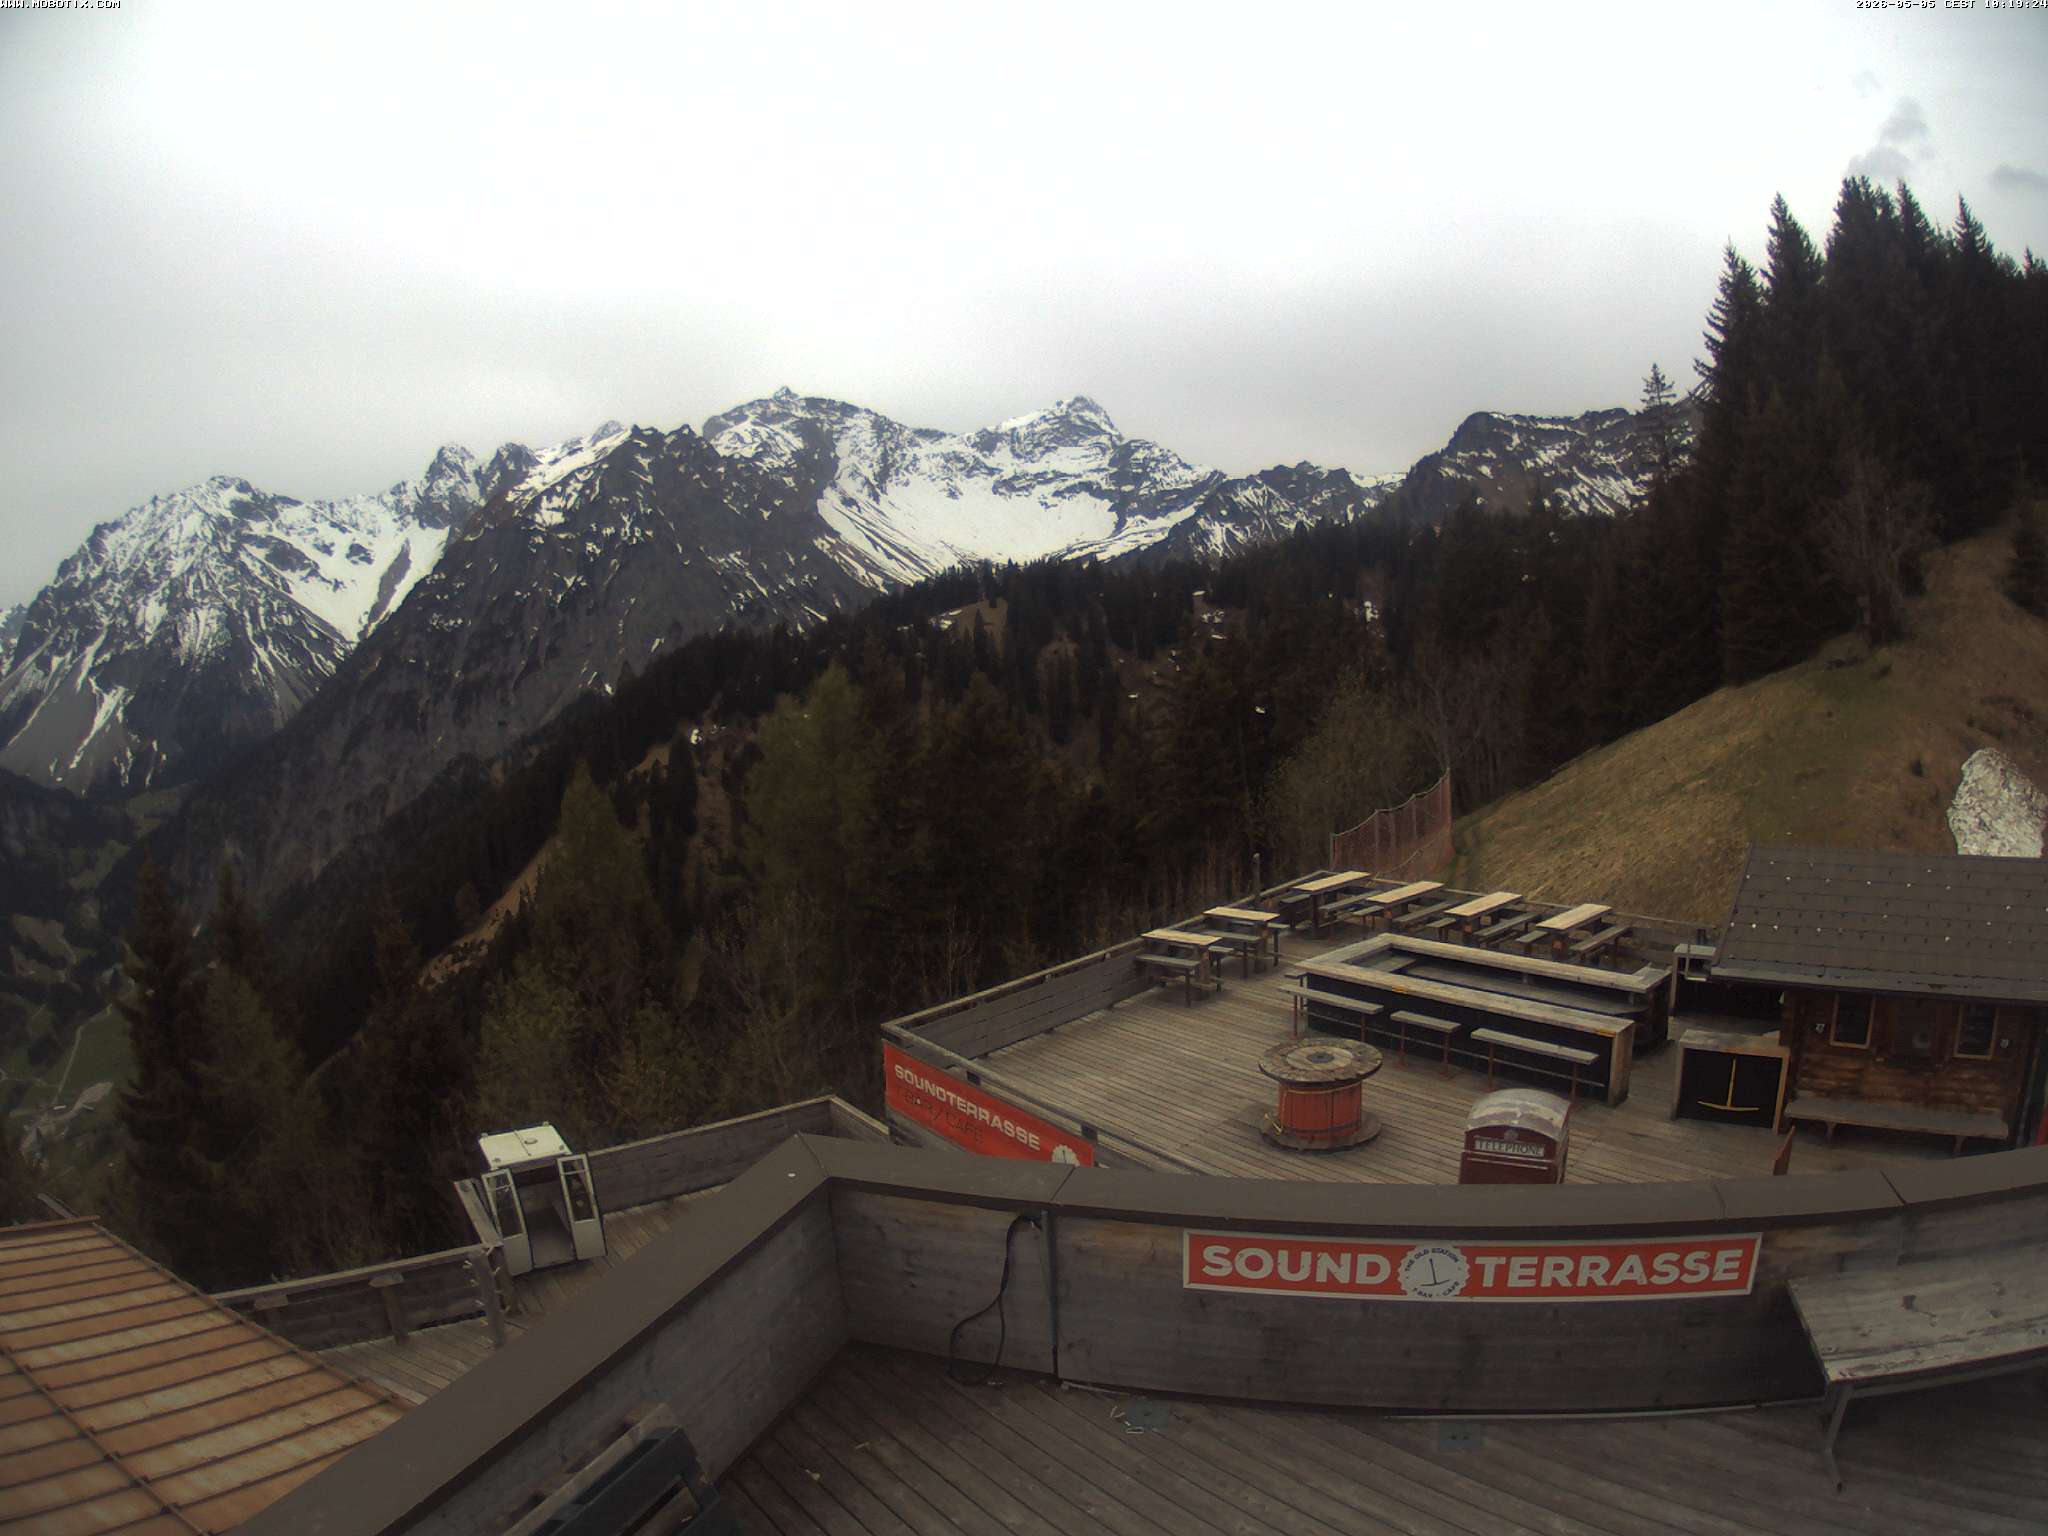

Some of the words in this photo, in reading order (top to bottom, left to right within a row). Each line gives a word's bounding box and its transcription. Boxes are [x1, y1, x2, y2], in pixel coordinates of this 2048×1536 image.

[894, 1064, 1041, 1152] SOUNDTERRASSE
[1477, 1139, 1544, 1156] TELEPHONE
[1202, 1244, 1391, 1285] SOUND
[1475, 1248, 1744, 1289] TERRASSE
[1414, 1248, 1430, 1260] OLD
